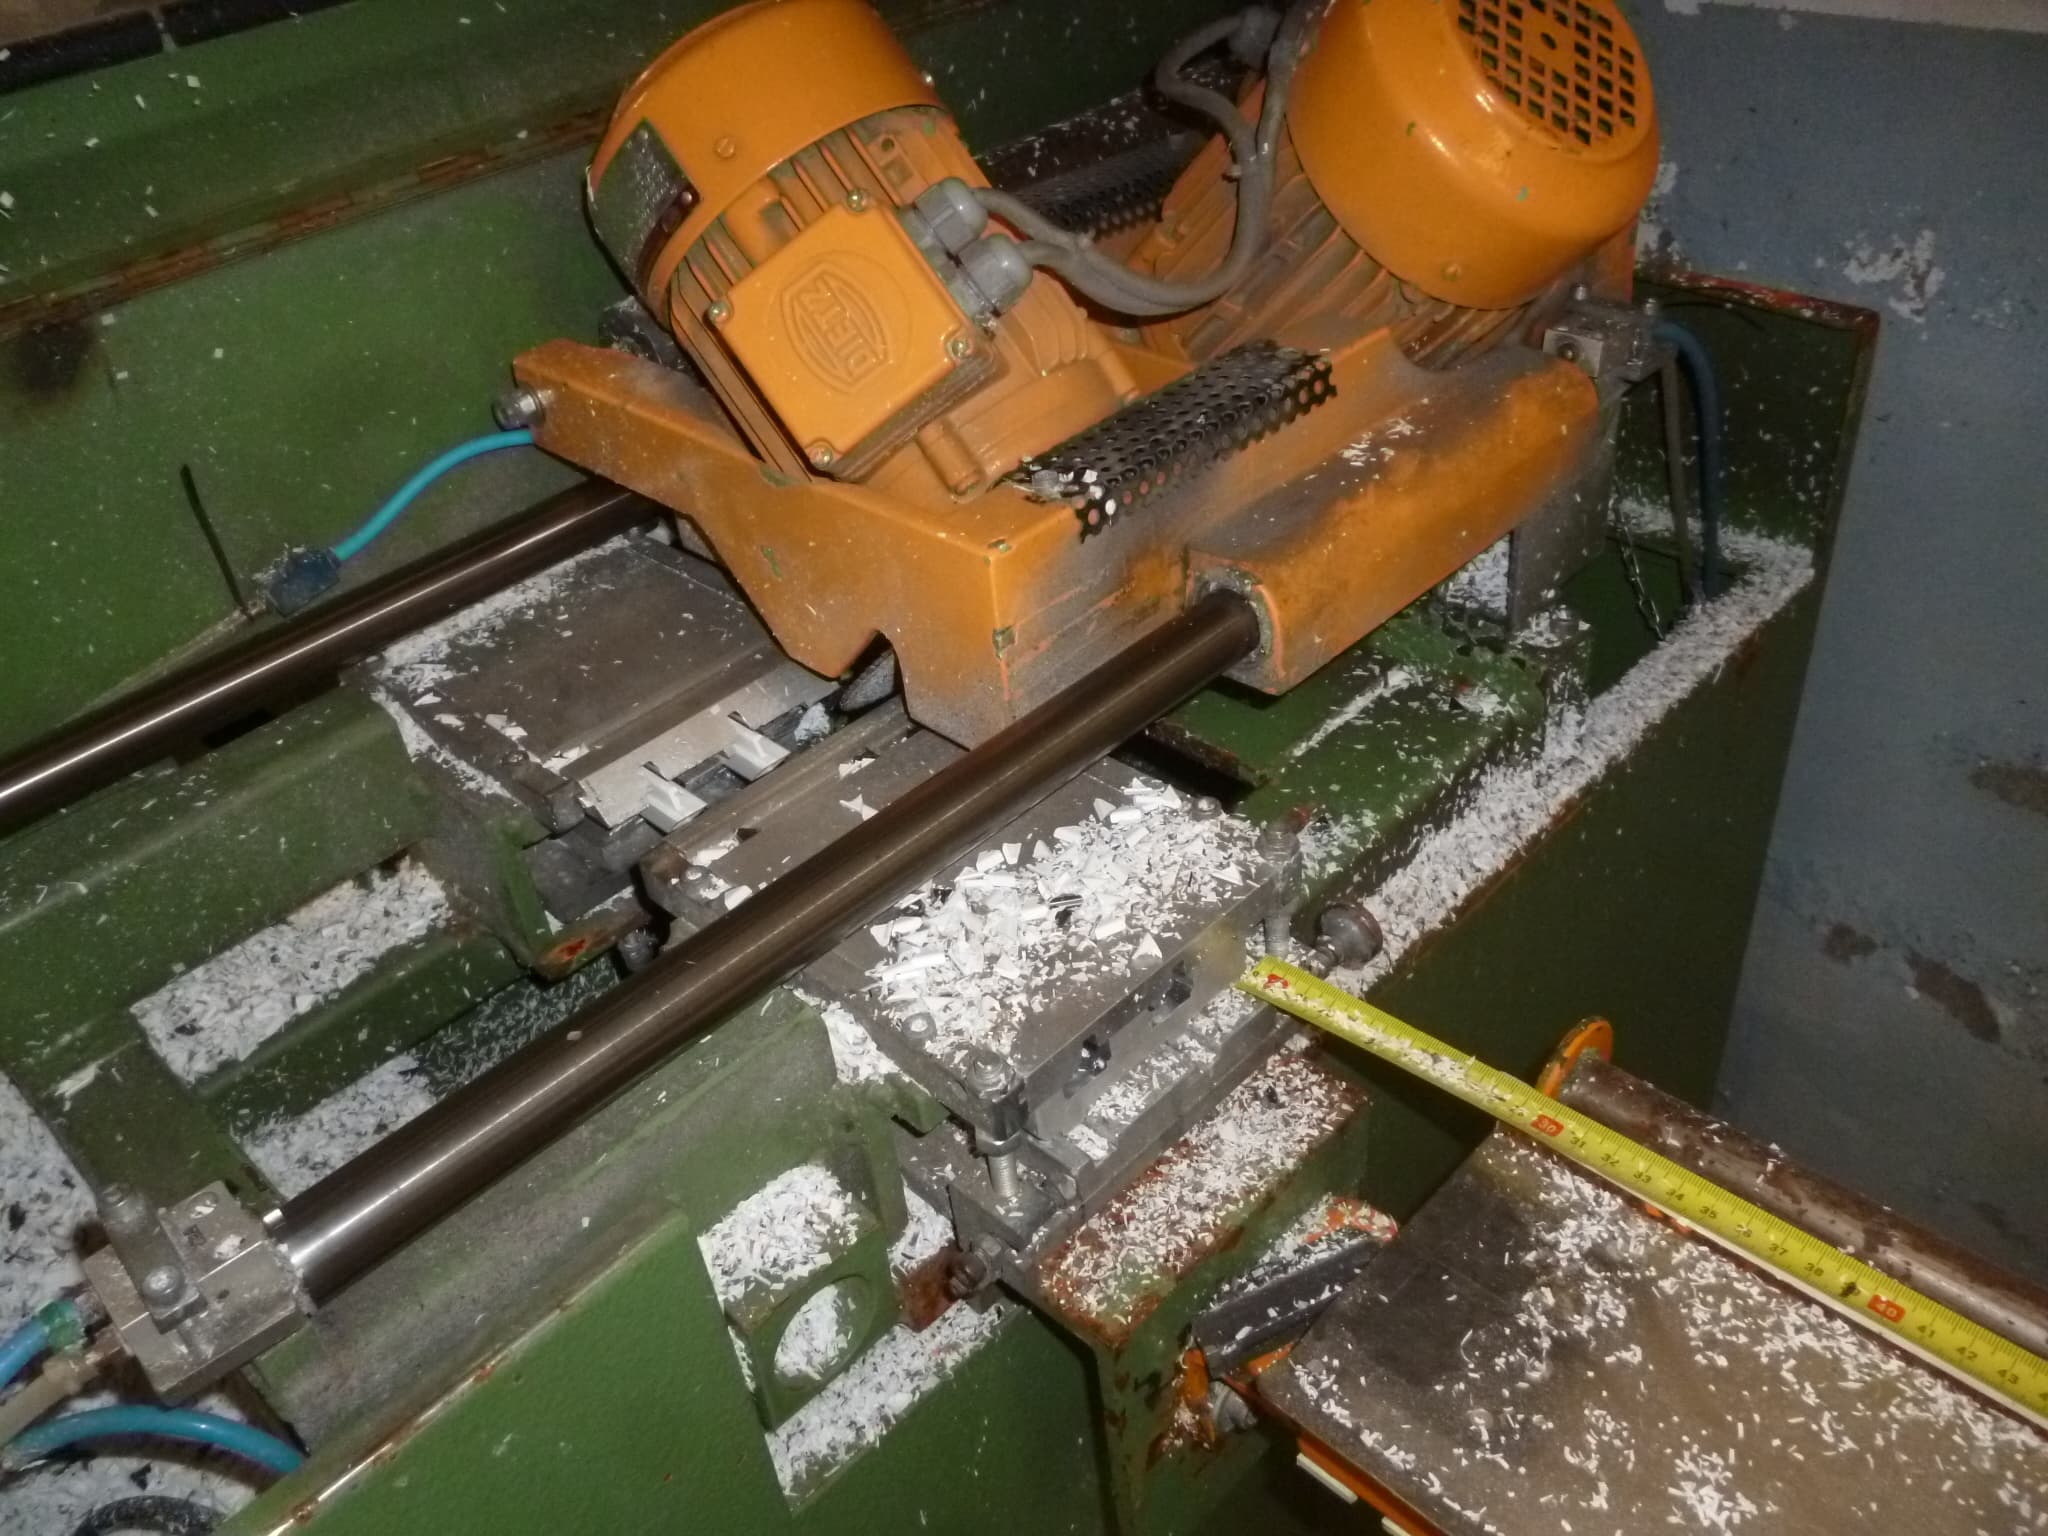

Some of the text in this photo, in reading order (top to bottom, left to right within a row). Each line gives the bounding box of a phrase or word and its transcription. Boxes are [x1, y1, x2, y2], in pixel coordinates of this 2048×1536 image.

[799, 278, 878, 377] DIETZ
[1537, 1117, 1557, 1132] 30
[1569, 1136, 1586, 1148] 31
[1600, 1153, 1620, 1167] 32
[1633, 1171, 1652, 1184] 33
[1665, 1188, 1685, 1201] 34
[1699, 1205, 1718, 1219] 35
[1768, 1243, 1788, 1256] 37
[1803, 1262, 1825, 1277] 38
[1876, 1302, 1898, 1318] 40
[1916, 1324, 1936, 1339] 41
[1955, 1346, 1979, 1361] 42
[1996, 1368, 2019, 1385] 43
